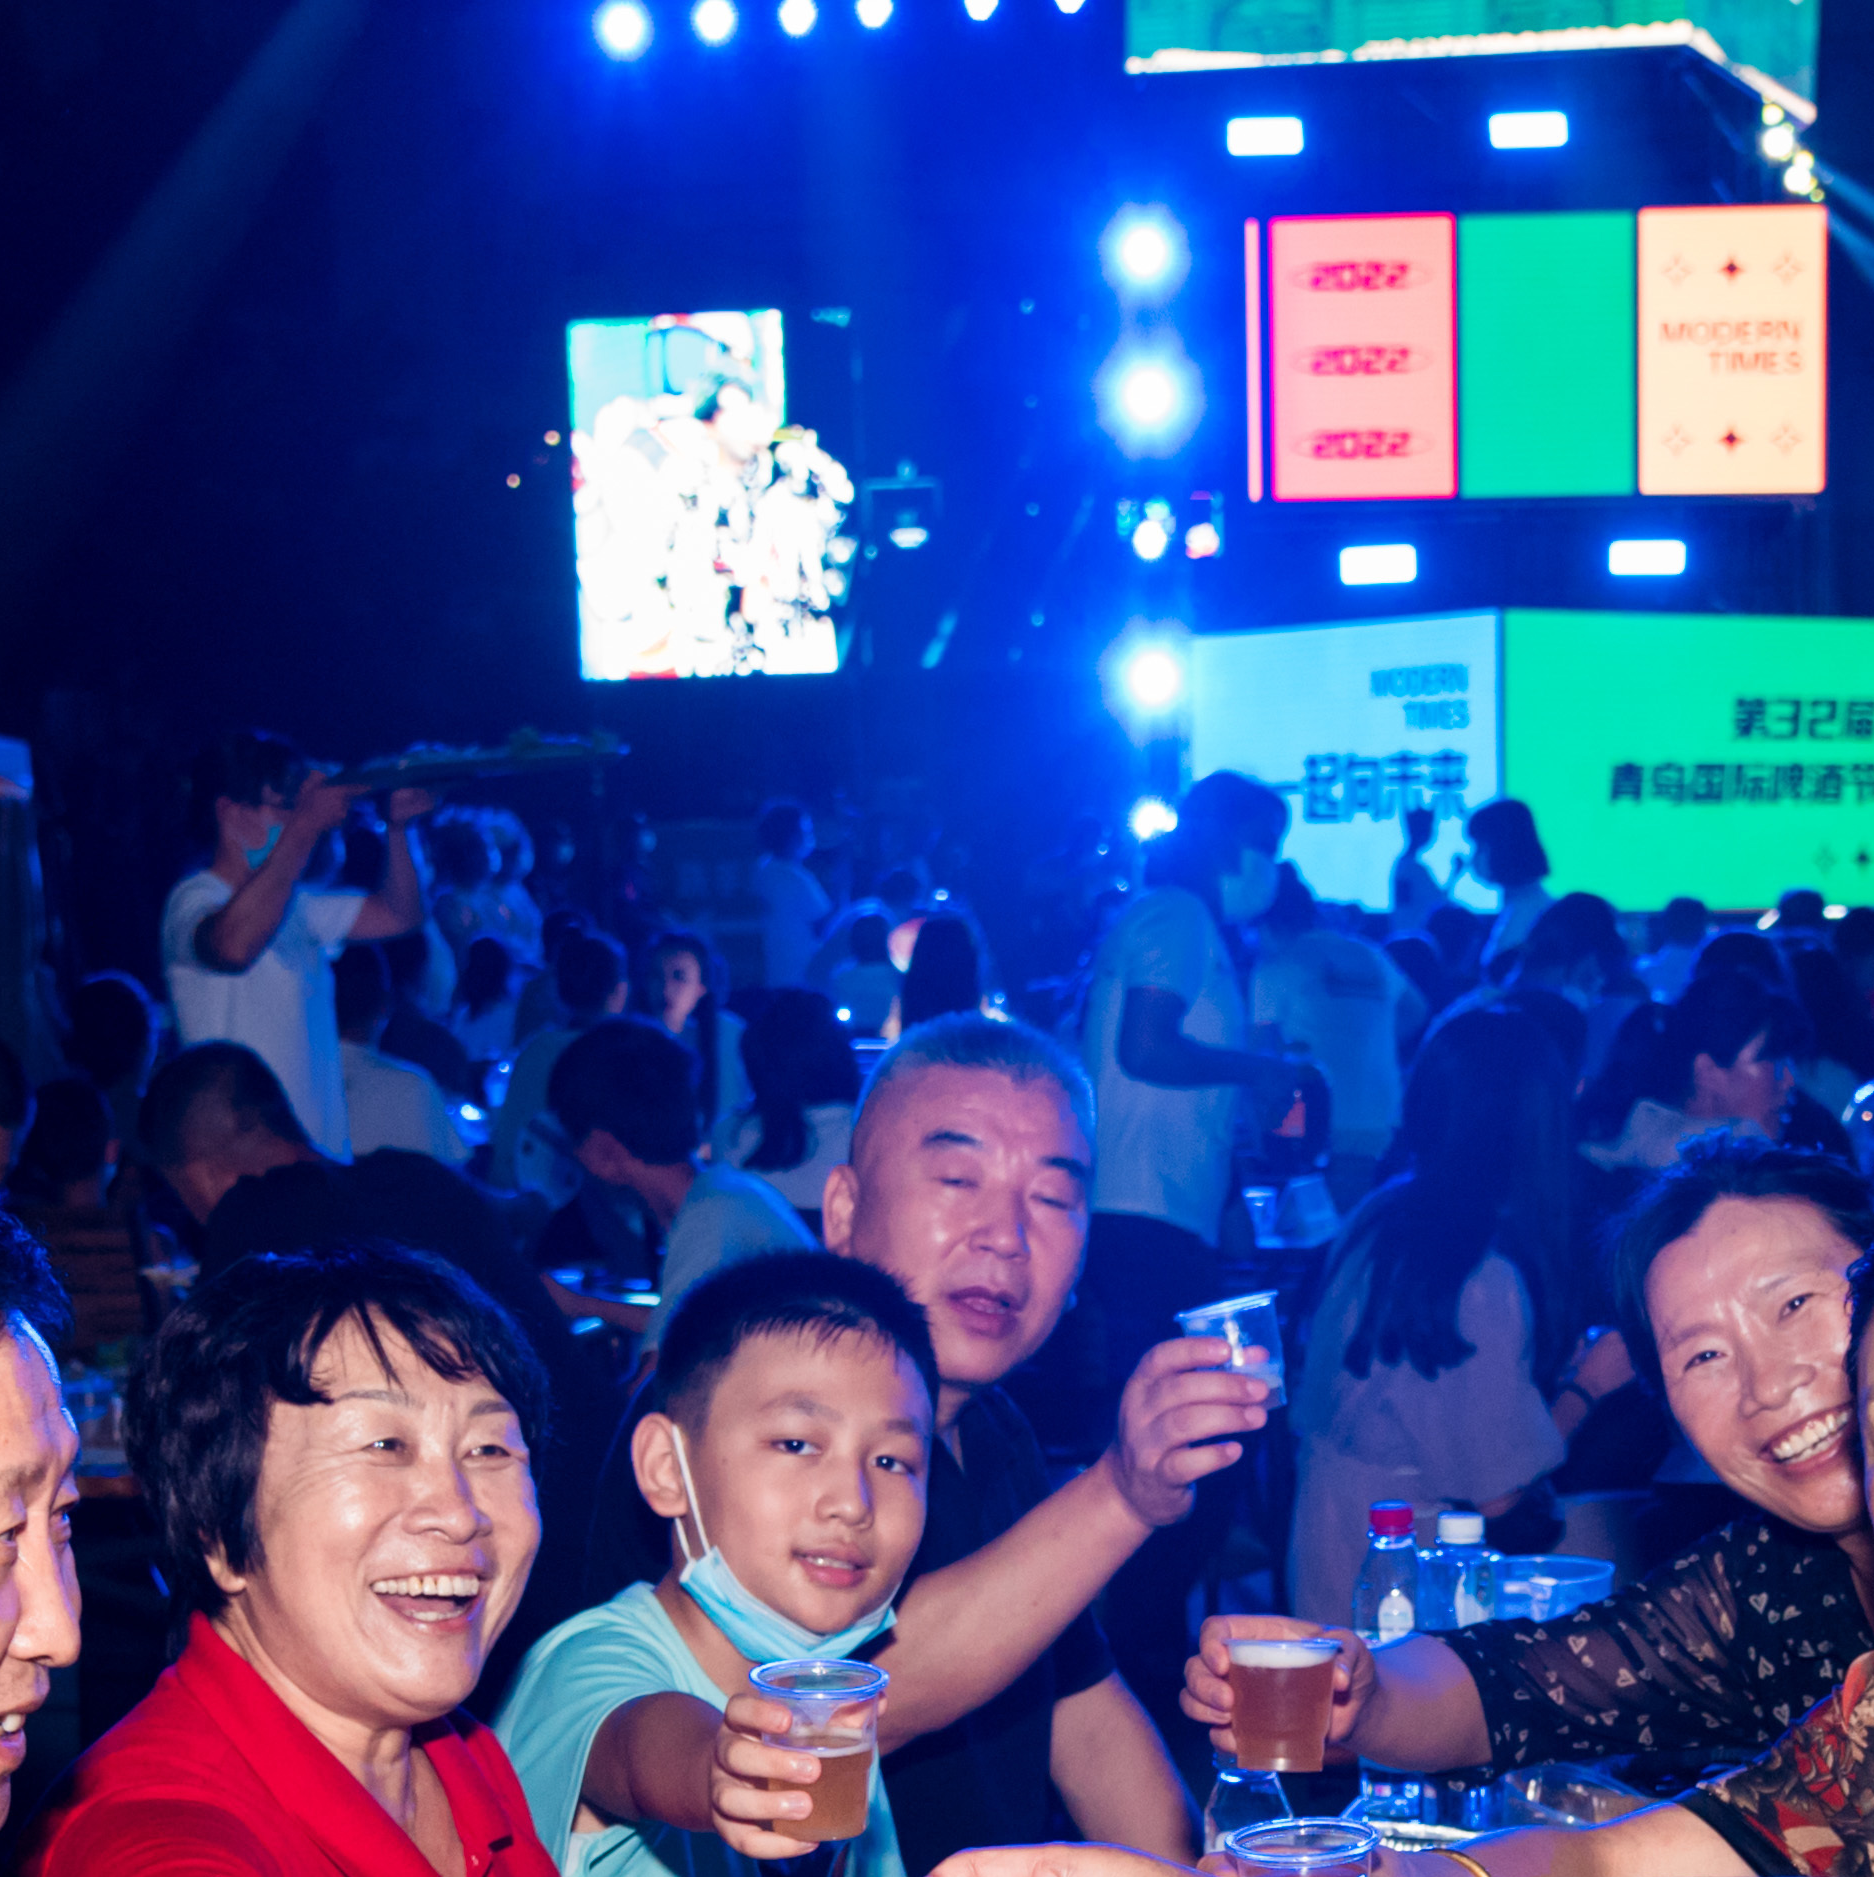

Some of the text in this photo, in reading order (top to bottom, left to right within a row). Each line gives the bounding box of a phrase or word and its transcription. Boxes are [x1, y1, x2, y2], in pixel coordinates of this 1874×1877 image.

[1309, 261, 1411, 291] 2022
[1660, 319, 1803, 346] MODERN
[1309, 346, 1411, 376] 2022
[1708, 349, 1803, 376] TIMES
[1309, 430, 1411, 460] 2022
